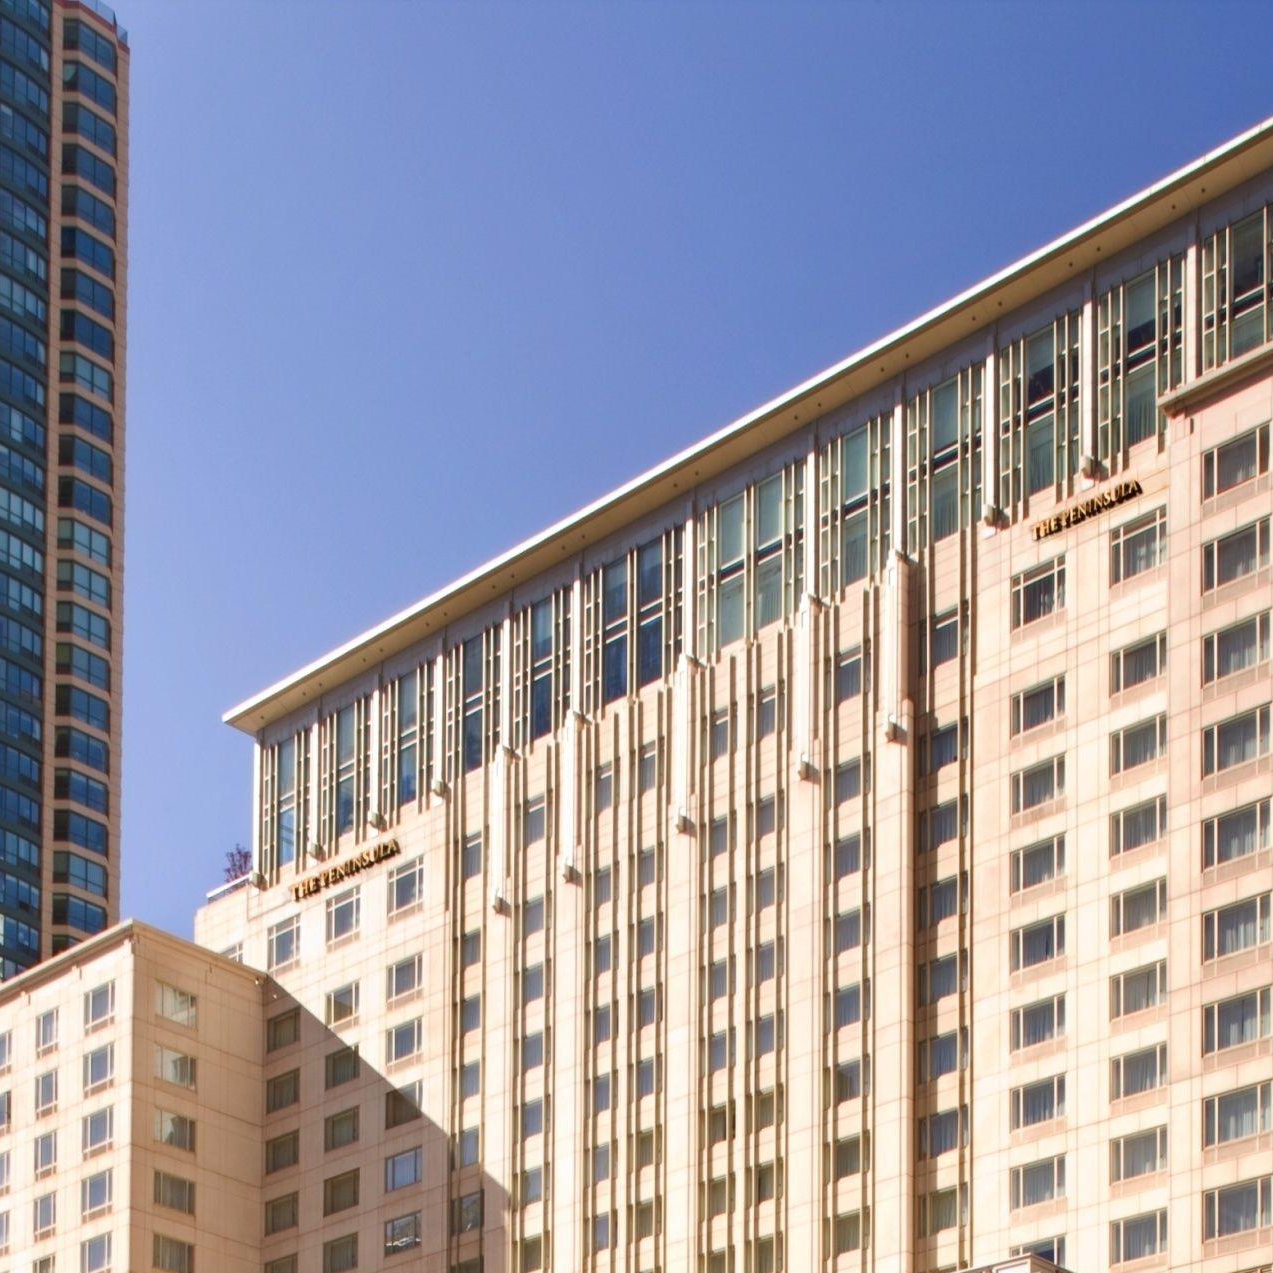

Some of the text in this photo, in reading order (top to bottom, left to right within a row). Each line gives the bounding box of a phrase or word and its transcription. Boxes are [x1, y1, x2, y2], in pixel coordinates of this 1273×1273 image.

[1031, 480, 1143, 540] THE PENINSULA
[289, 839, 401, 902] THE PENINSULA
